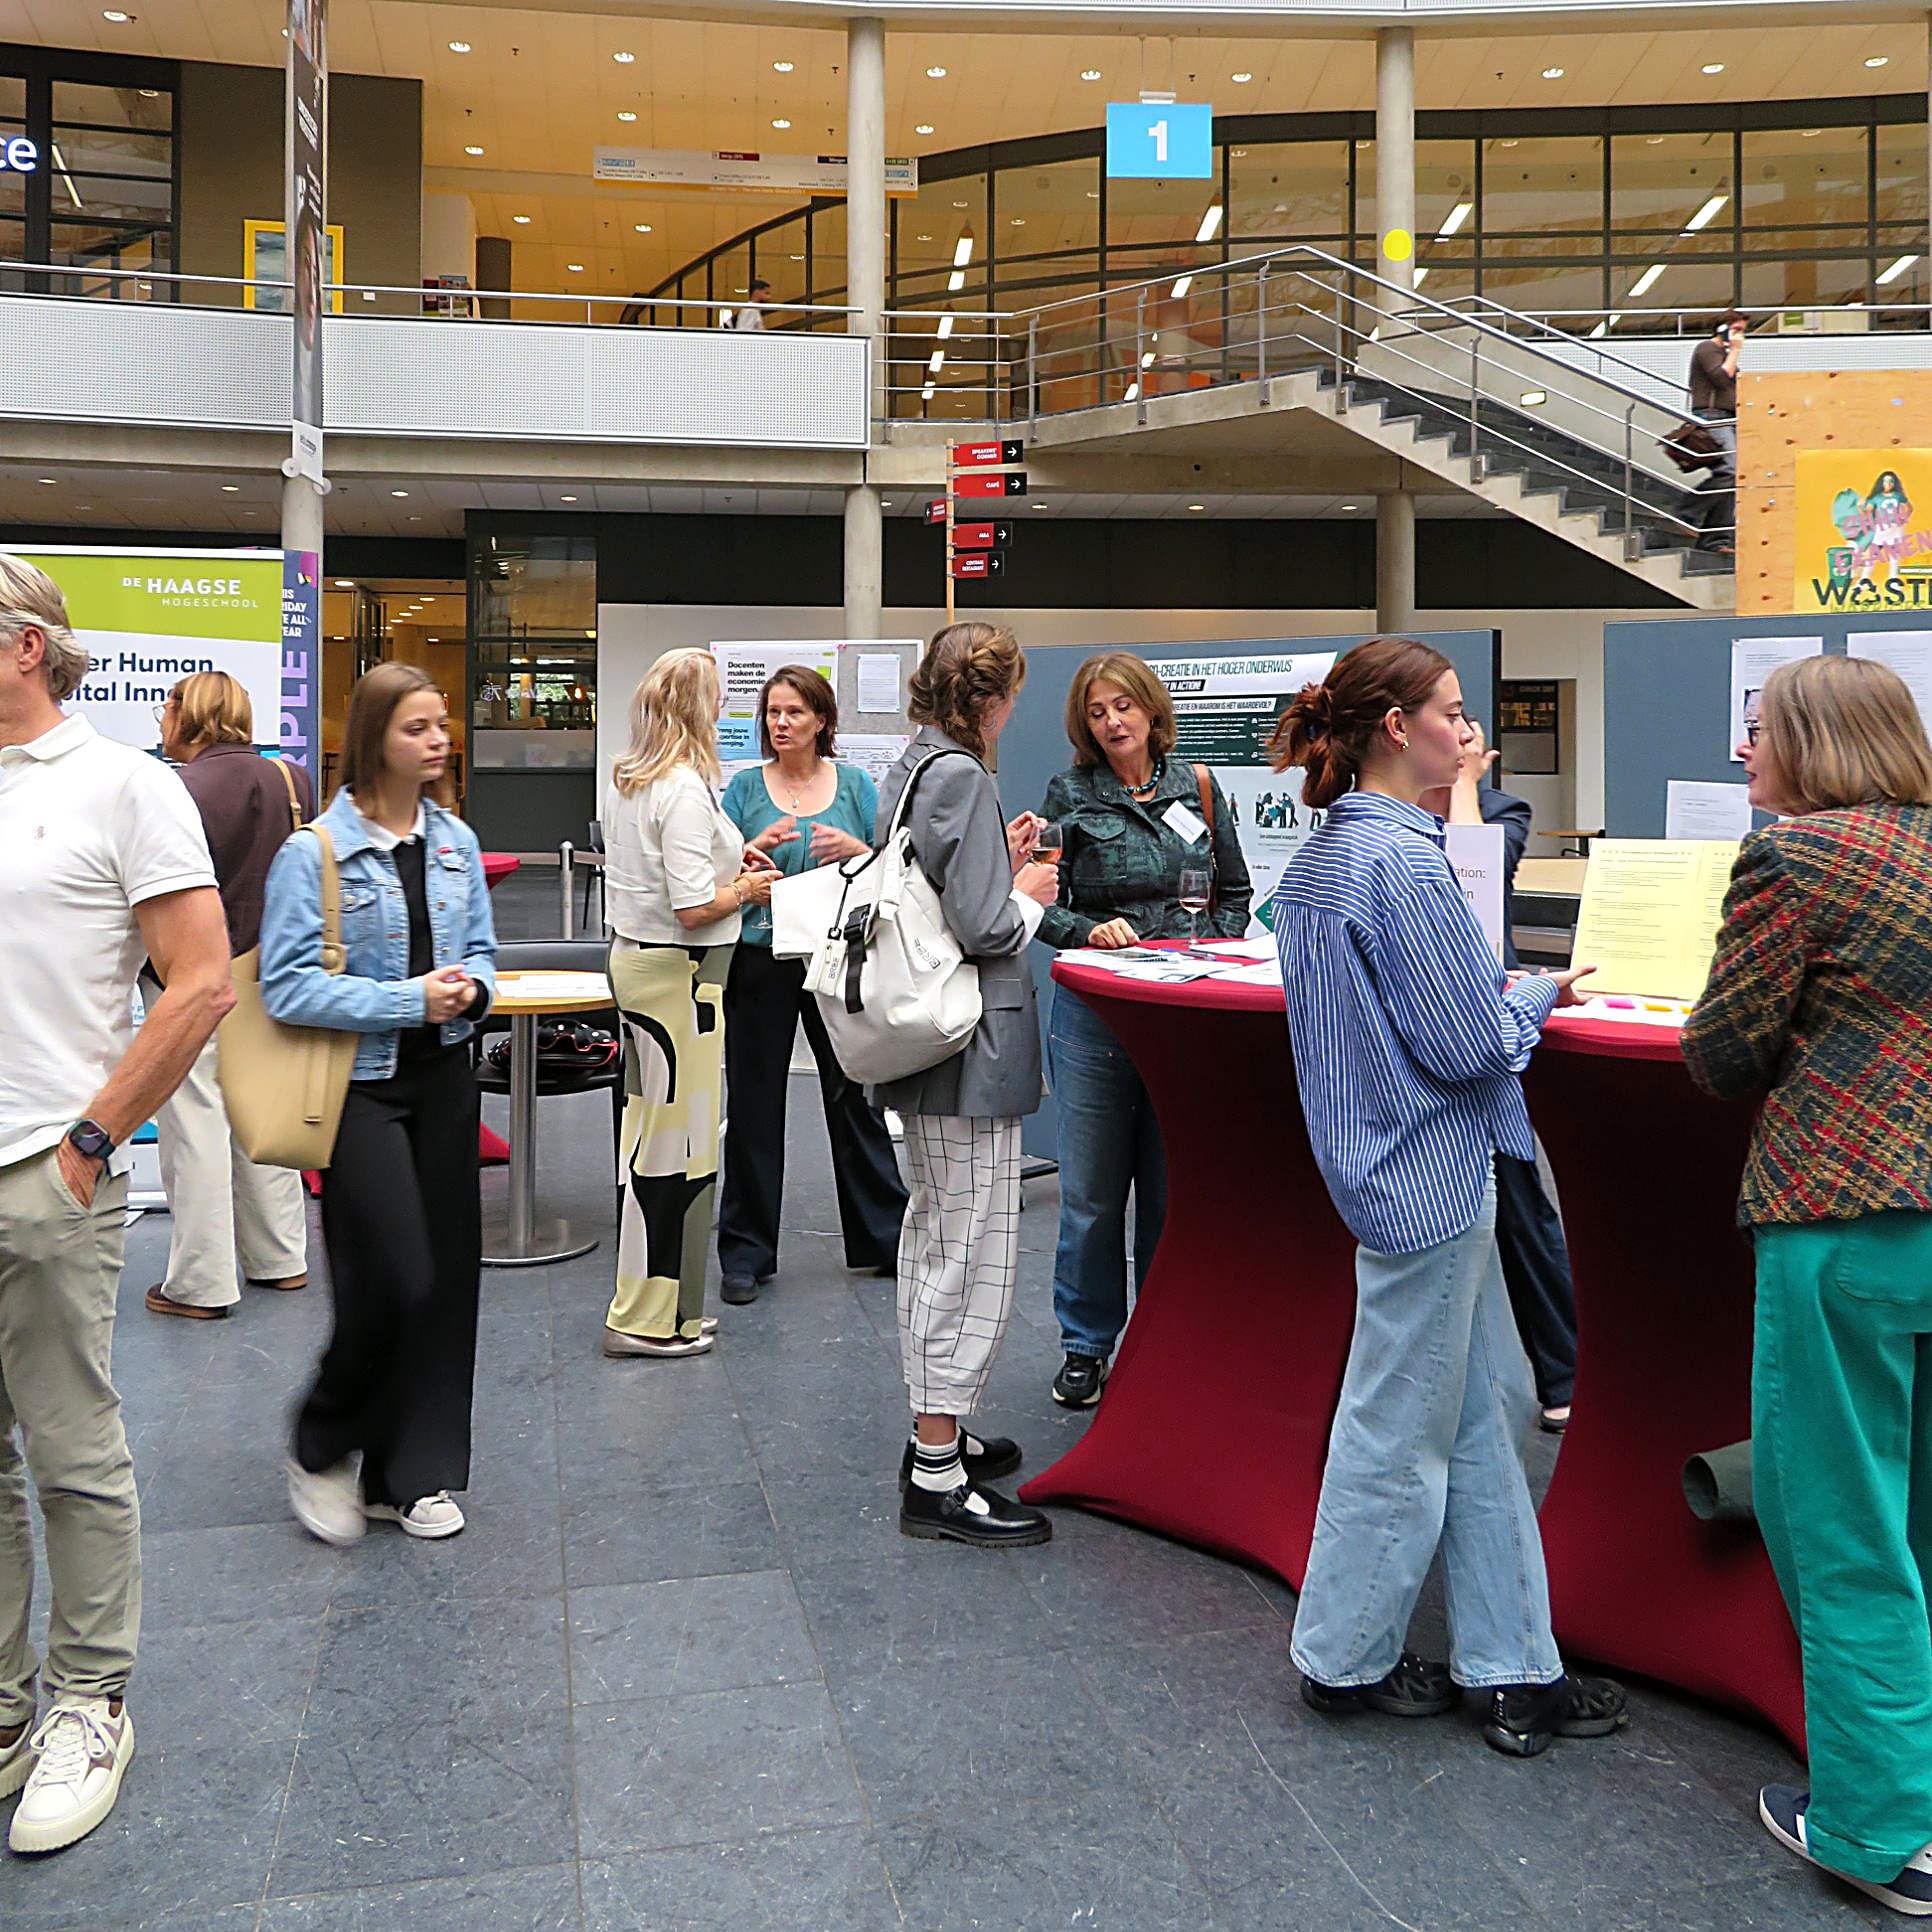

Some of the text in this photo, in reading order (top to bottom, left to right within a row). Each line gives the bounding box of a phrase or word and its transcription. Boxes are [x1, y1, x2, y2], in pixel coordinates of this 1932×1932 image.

[1147, 119, 1168, 161] 1
[122, 577, 241, 595] DE HAAGSE
[162, 598, 258, 608] HOGESCHOOL
[88, 652, 213, 673] er Human
[1201, 662, 1217, 676] HET
[1218, 661, 1244, 674] HOGER
[65, 682, 172, 702] ital Inn
